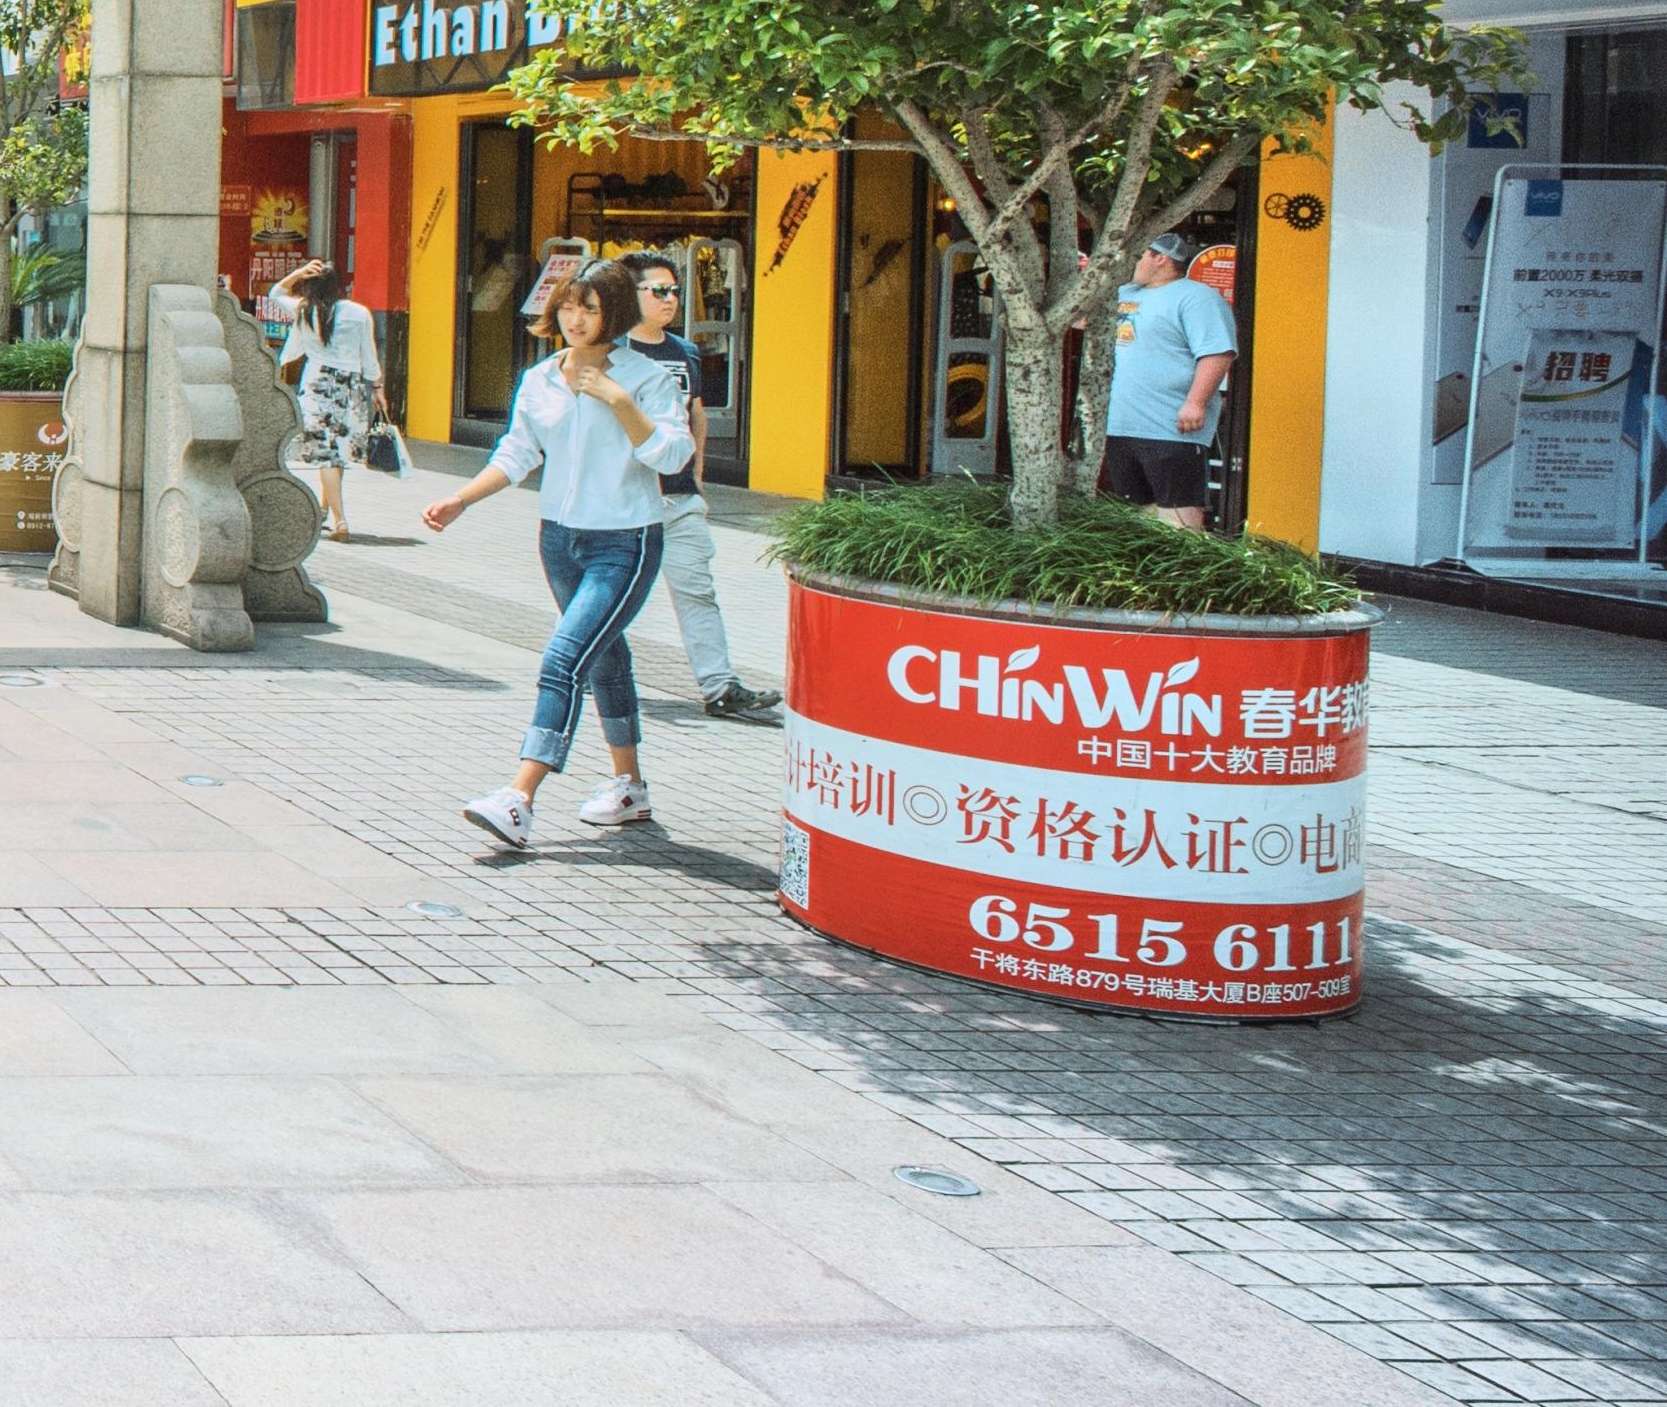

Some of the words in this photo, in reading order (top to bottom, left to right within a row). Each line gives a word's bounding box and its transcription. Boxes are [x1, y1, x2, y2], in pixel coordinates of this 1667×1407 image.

[1543, 351, 1612, 382] 招聘
[1077, 736, 1337, 775] 中国十大教育品牌
[956, 783, 1249, 875] 资格认证
[969, 895, 1187, 966] 6515
[1213, 916, 1354, 972] 6111
